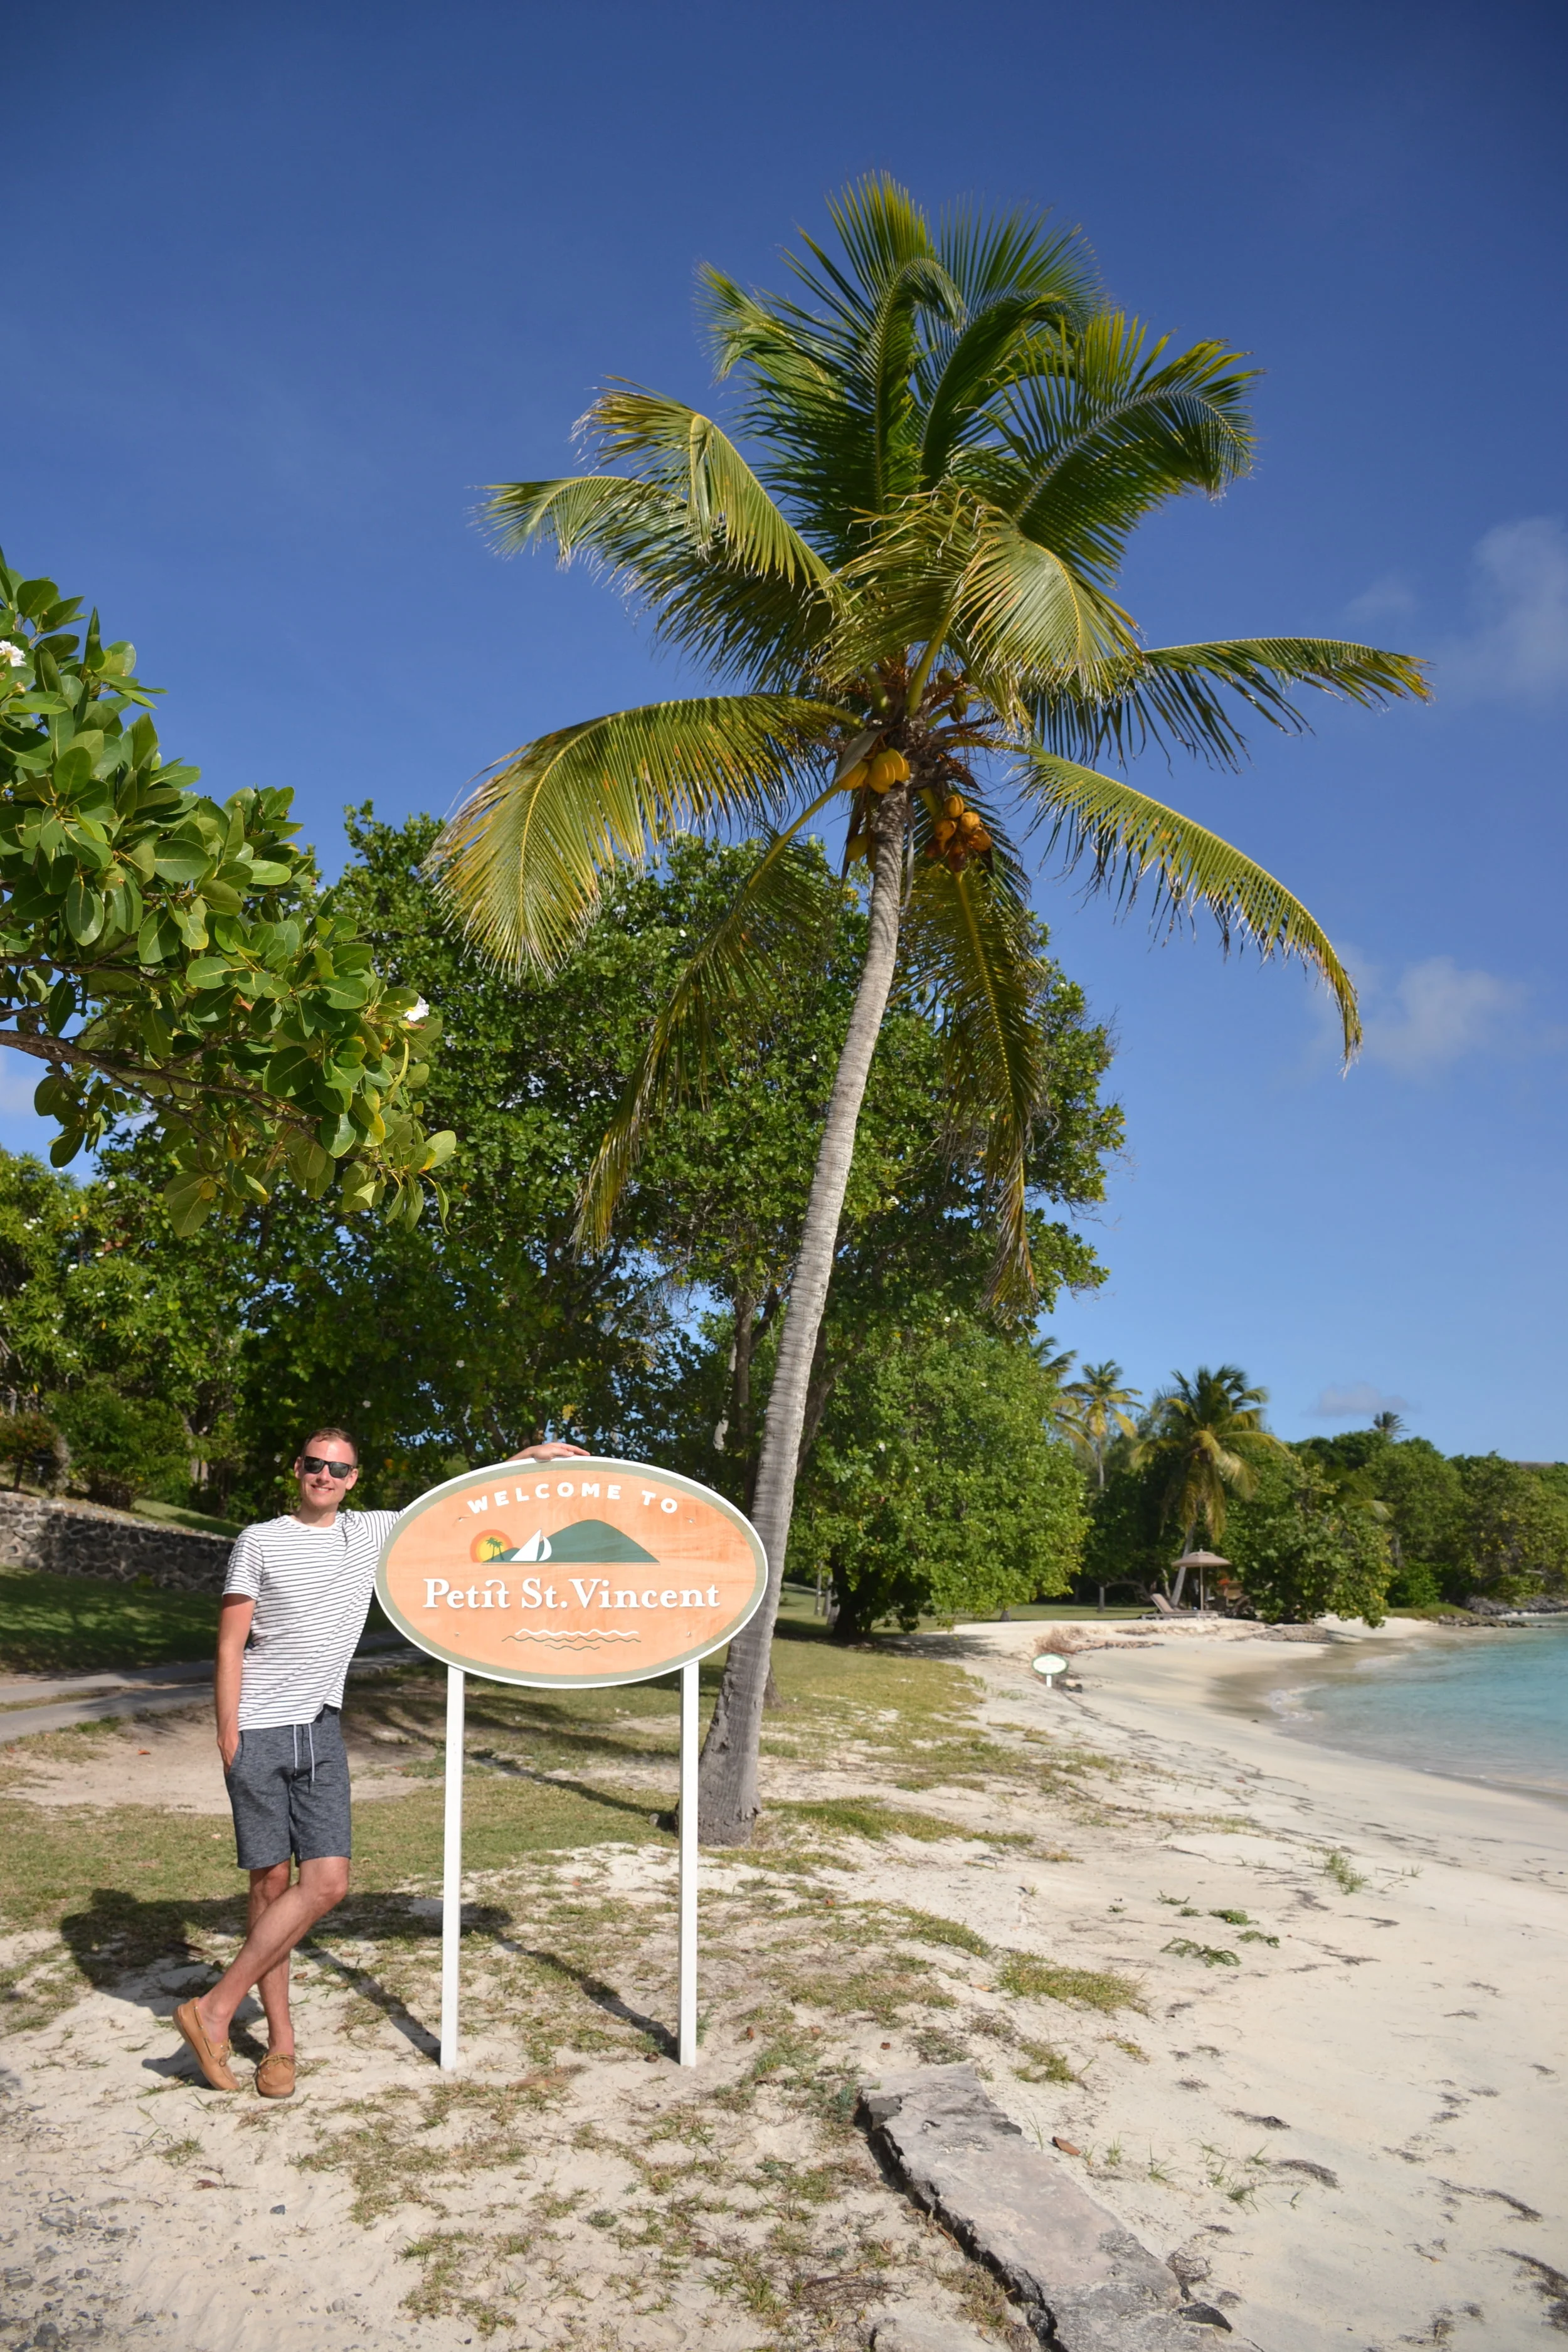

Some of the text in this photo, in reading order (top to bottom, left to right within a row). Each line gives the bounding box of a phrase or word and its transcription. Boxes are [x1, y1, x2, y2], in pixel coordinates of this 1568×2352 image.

[467, 1481, 678, 1514] WELCOME TO
[422, 1577, 721, 1609] Petit St. Vincent
